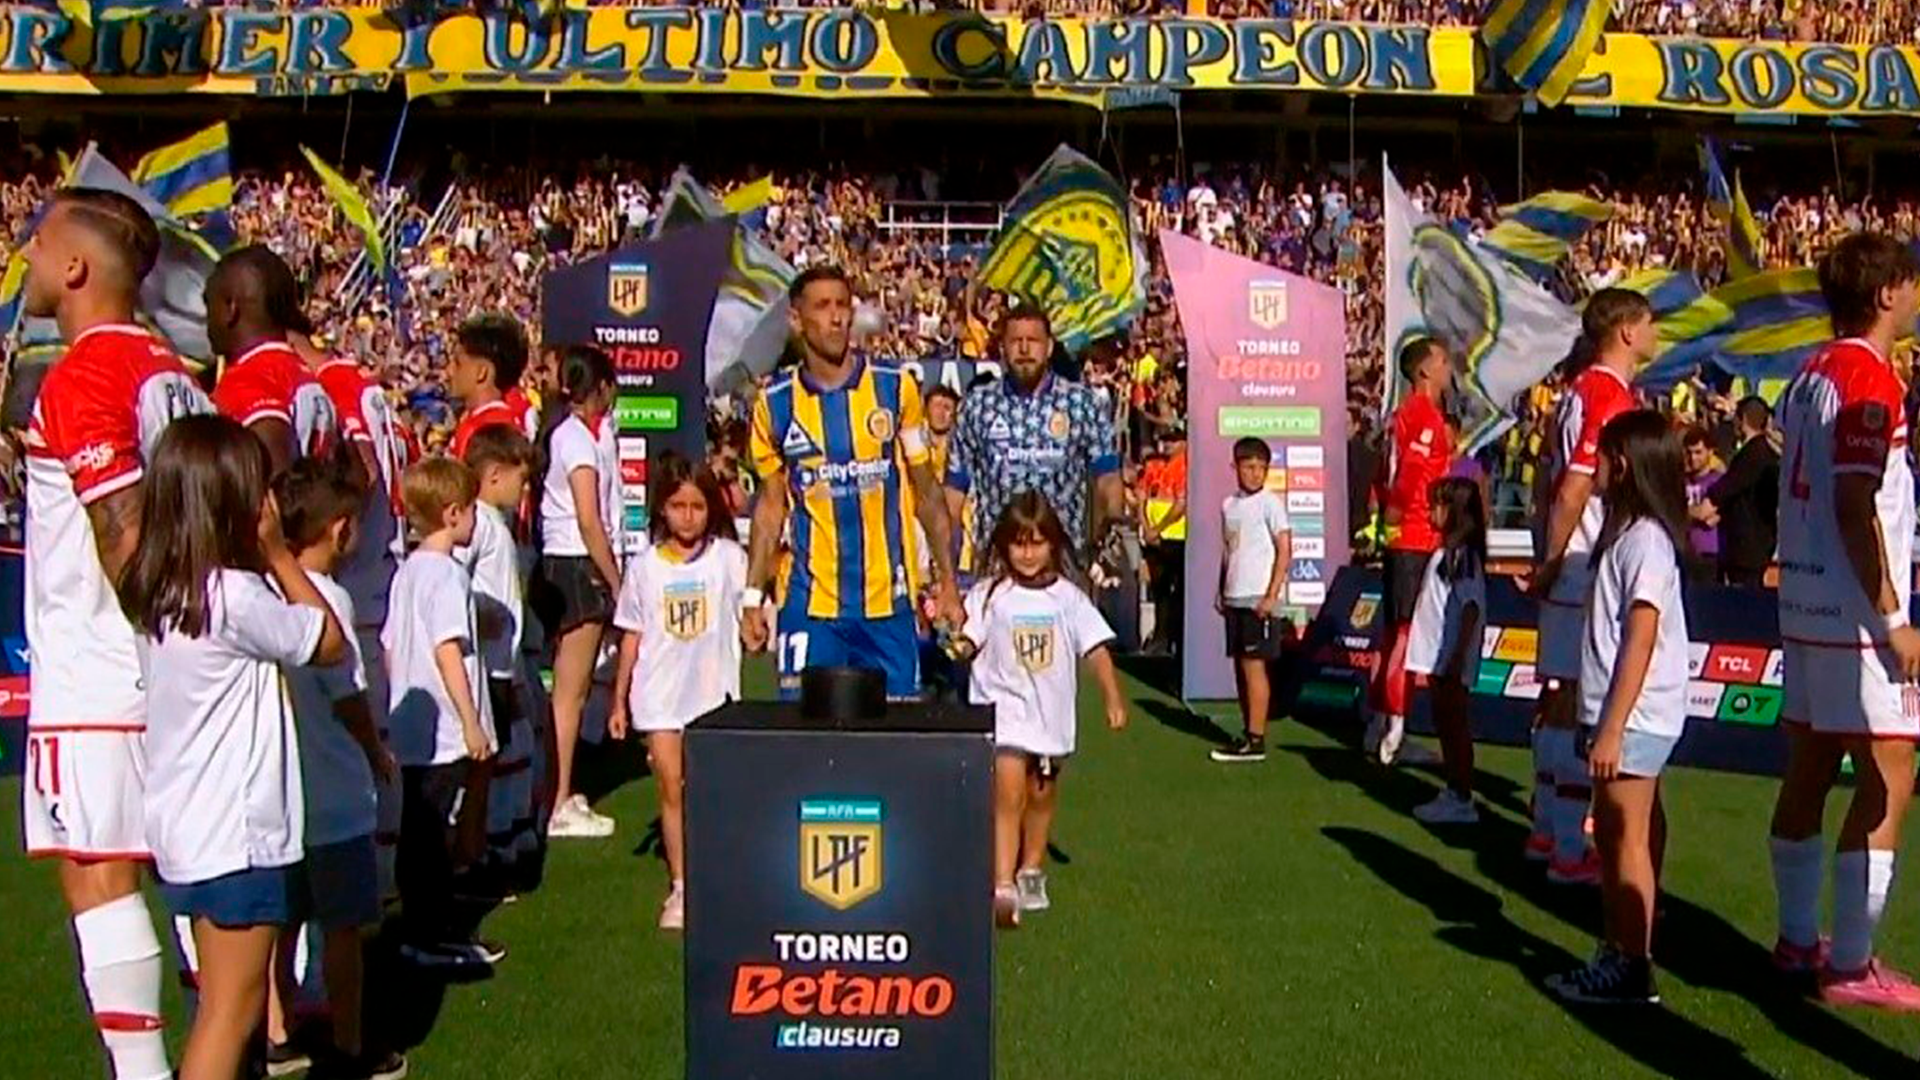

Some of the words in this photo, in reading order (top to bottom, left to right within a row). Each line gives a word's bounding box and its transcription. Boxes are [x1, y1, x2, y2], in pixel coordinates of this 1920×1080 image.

[931, 17, 1433, 91] CAMPEON
[594, 327, 660, 343] TORNEO
[1237, 340, 1300, 355] TORNEO
[609, 346, 679, 369] tano
[1217, 355, 1321, 380] Betano
[1242, 382, 1296, 397] clausura
[819, 458, 891, 484] CityCenter
[1718, 655, 1752, 672] TCL
[813, 834, 870, 894] LPF
[773, 933, 909, 962] TORNEO
[731, 964, 953, 1017] Betano
[781, 1021, 901, 1047] clausura
